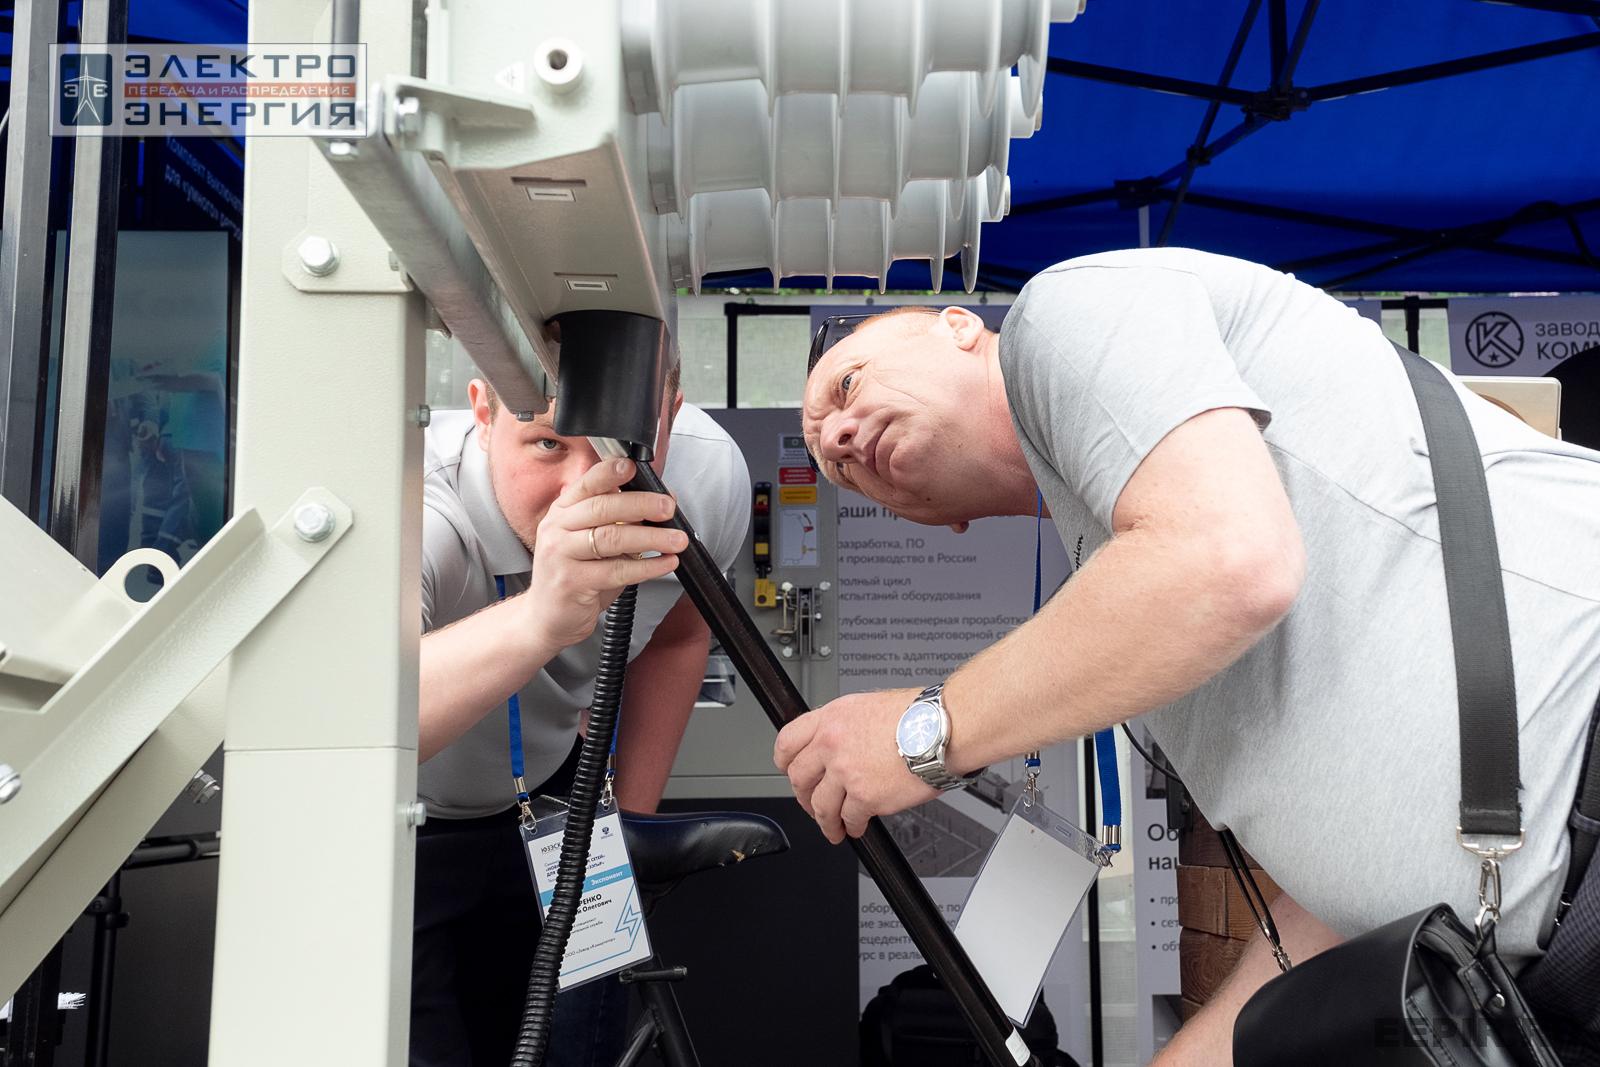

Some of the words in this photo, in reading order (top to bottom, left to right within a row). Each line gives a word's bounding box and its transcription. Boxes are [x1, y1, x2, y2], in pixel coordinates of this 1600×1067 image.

[1536, 341, 1599, 360] КОМ
[838, 506, 877, 518] аши
[906, 539, 925, 549] ПО
[847, 556, 925, 566] производство
[937, 553, 976, 564] России
[883, 578, 911, 588] цикл
[901, 590, 981, 602] оборудования
[890, 617, 959, 626] инженерная
[907, 631, 993, 642] внедоговорной
[891, 667, 912, 678] под
[579, 893, 602, 906] РЕНКО
[582, 899, 612, 913] Олегович
[860, 936, 911, 945] ецедент
